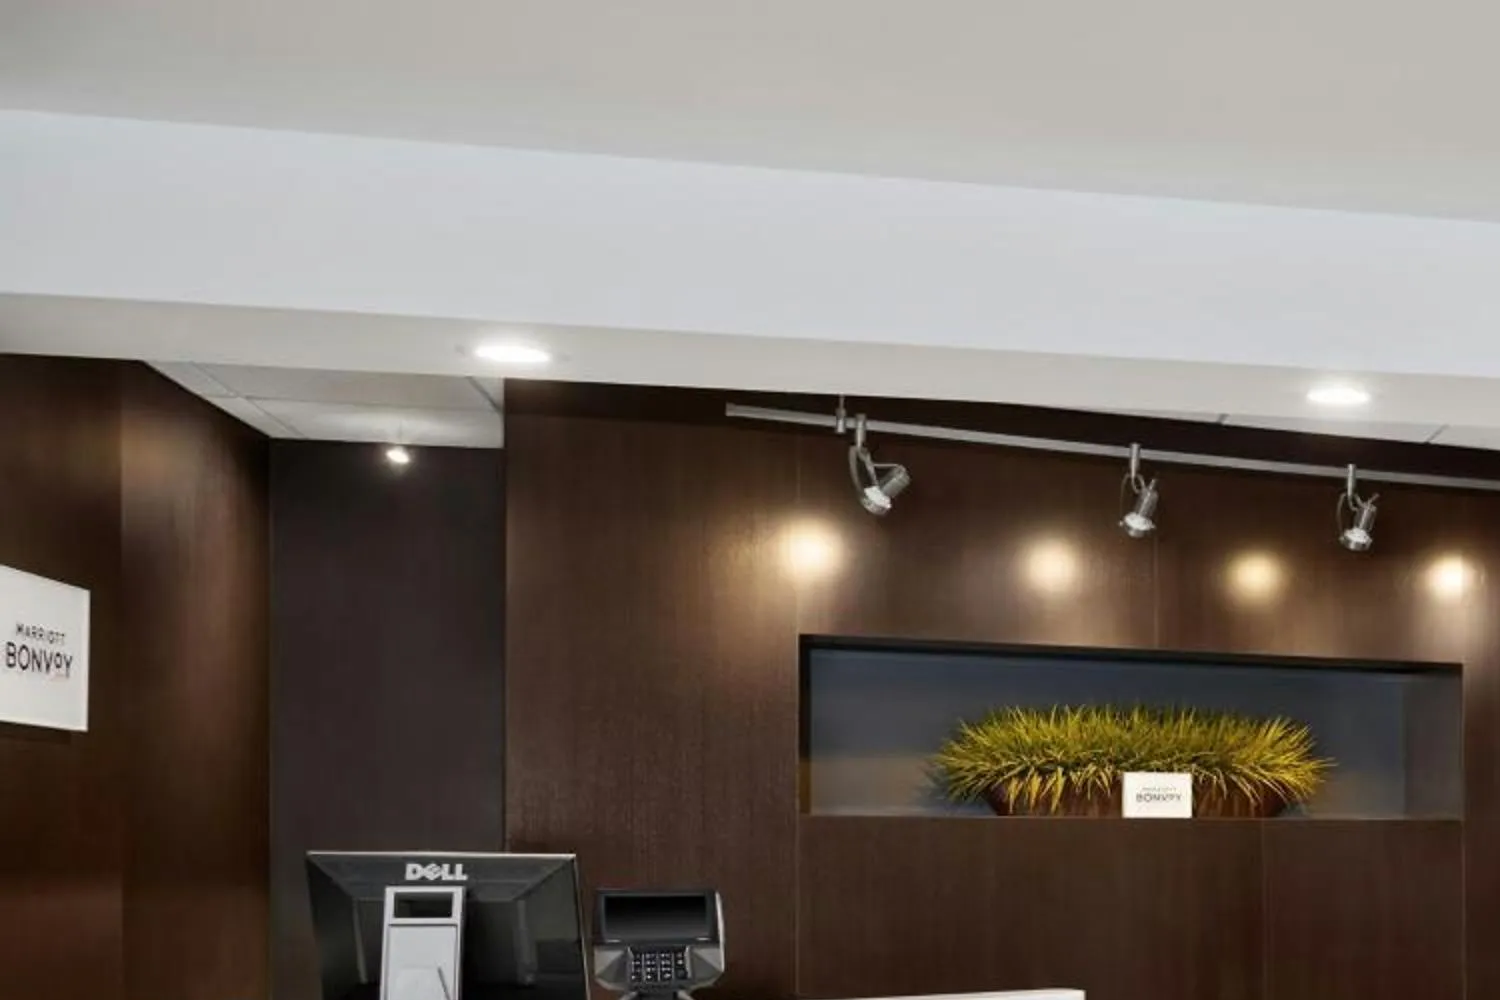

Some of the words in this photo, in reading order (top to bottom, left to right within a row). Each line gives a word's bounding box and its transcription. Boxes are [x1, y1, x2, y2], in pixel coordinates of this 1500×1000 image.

[15, 622, 65, 646] MARRIOTT
[6, 641, 73, 678] BONVOY
[405, 863, 468, 881] DELL
